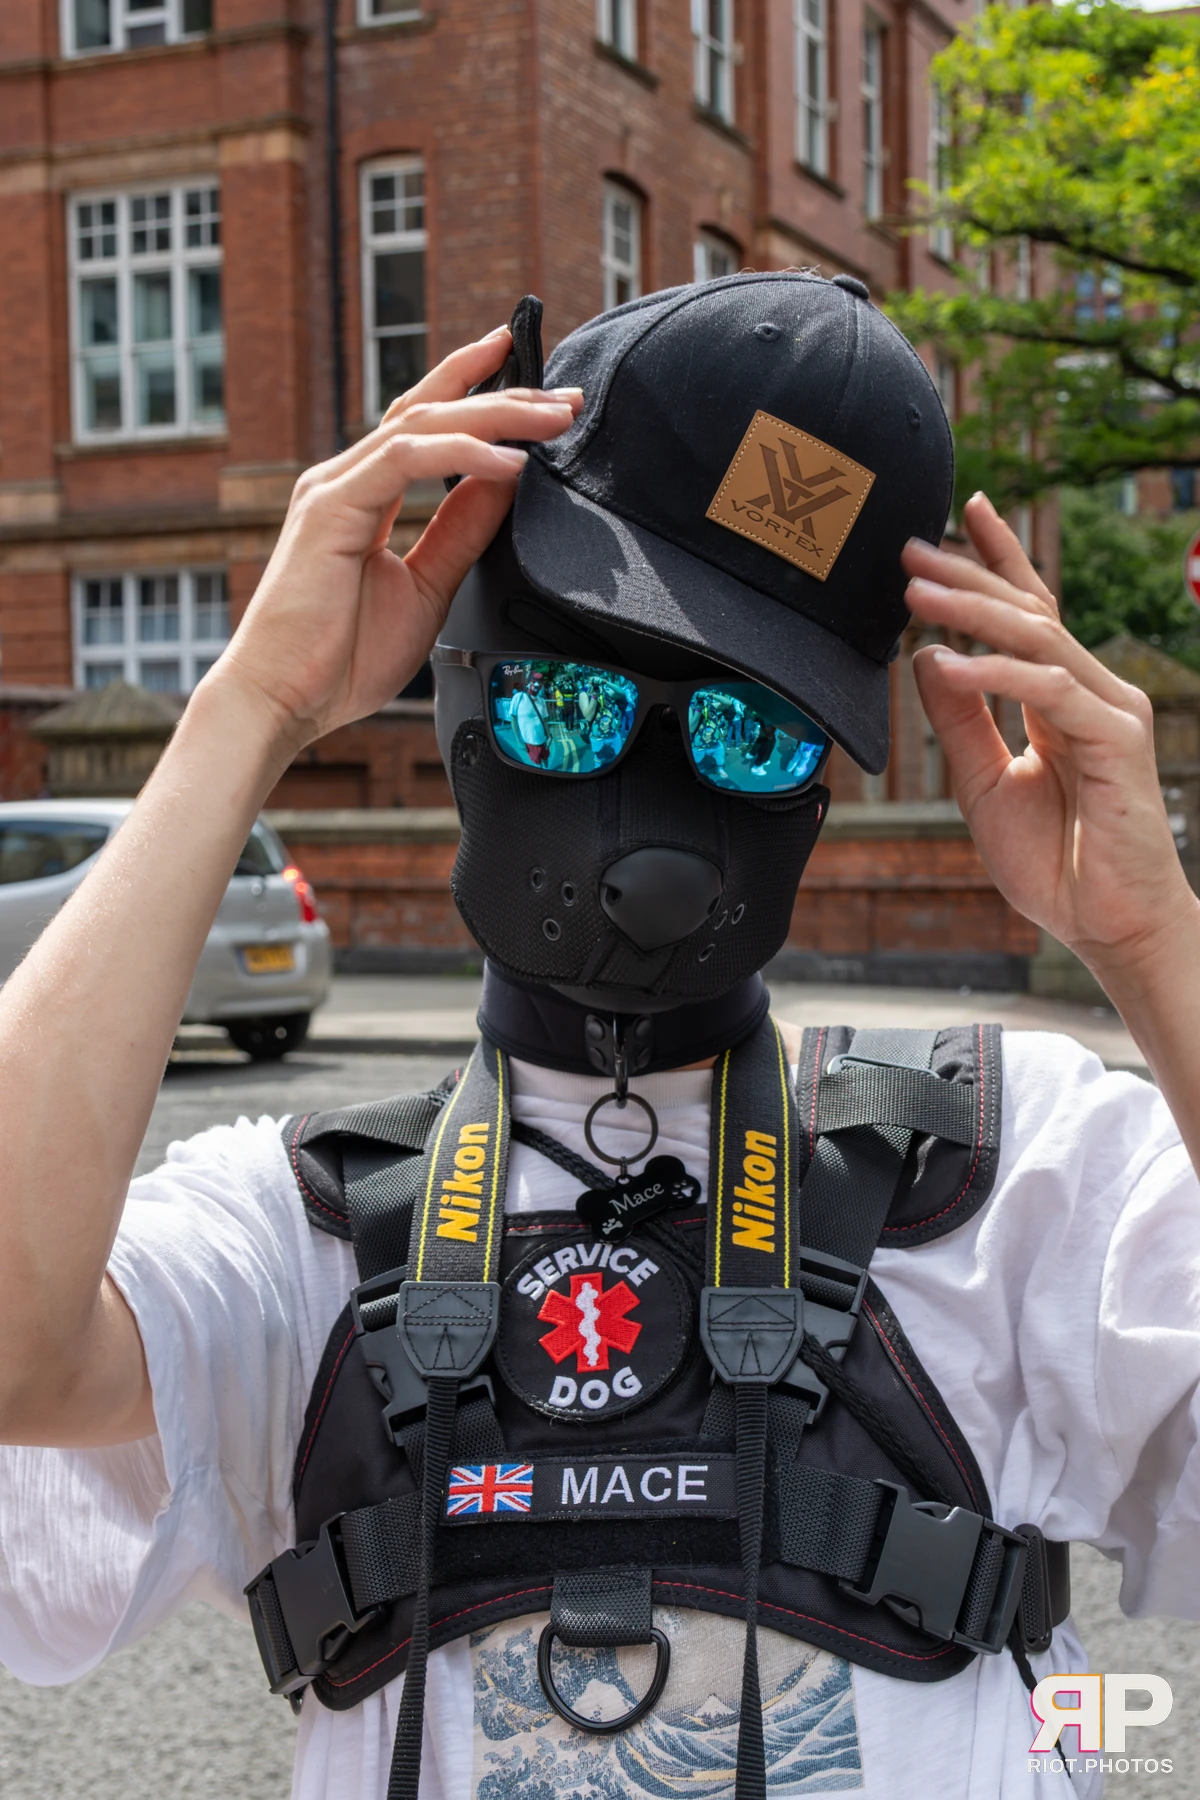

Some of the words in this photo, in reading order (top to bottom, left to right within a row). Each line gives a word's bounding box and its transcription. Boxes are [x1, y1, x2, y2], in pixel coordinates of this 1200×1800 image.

[731, 499, 824, 558] VORTEX
[436, 1122, 490, 1243] Nikon
[608, 1183, 665, 1215] Mace
[732, 1129, 777, 1254] Nikon
[516, 1242, 660, 1301] SERVICE
[548, 1366, 643, 1409] DOG
[561, 1464, 708, 1505] MACE
